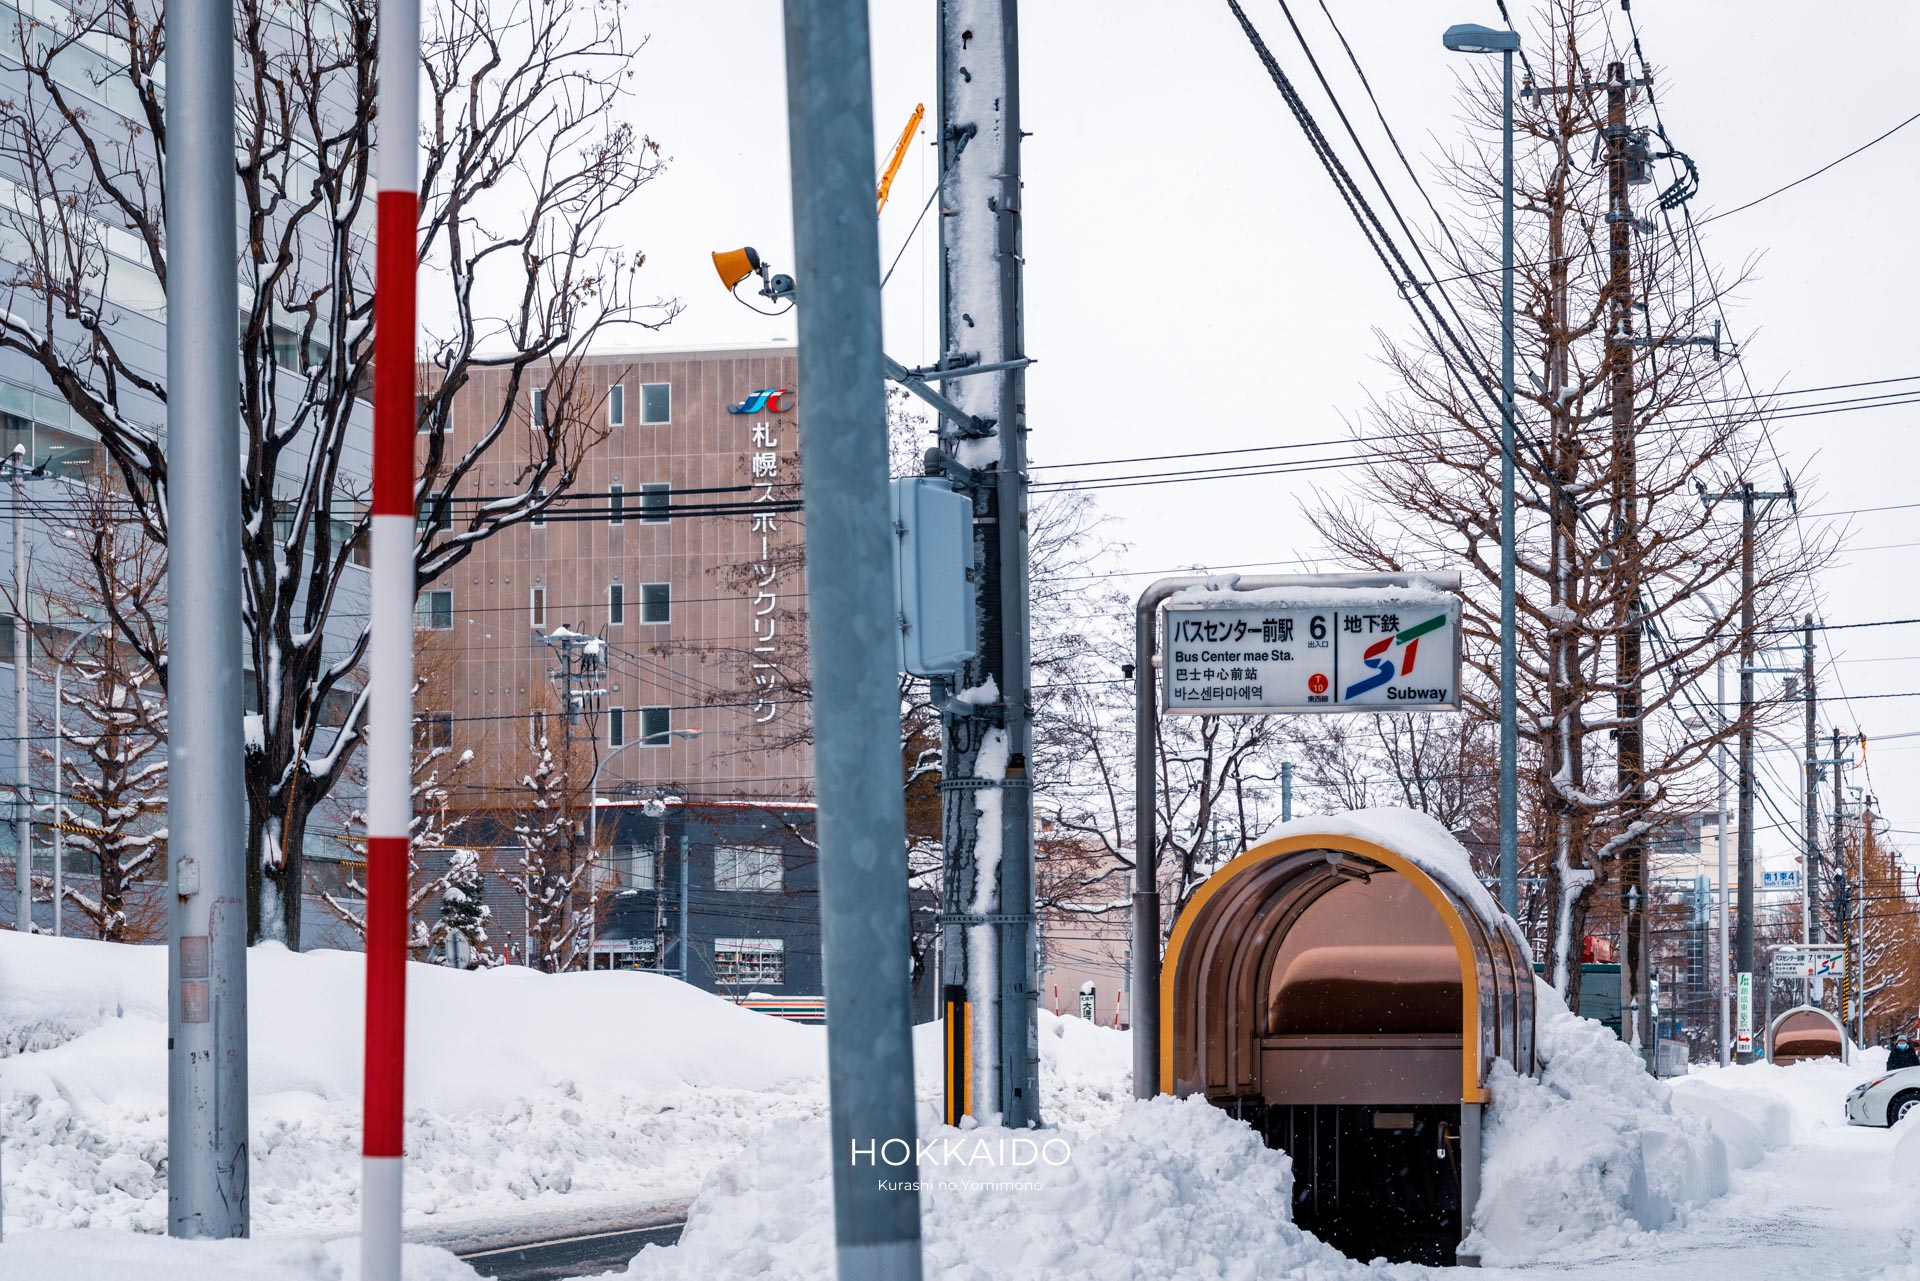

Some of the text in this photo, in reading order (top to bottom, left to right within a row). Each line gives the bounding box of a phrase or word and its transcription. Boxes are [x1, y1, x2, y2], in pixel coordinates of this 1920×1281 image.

[751, 422, 777, 723] 札幌スポーツクリニック
[1174, 618, 1294, 642] バスセンター前駅
[1309, 615, 1326, 640] 6
[1344, 614, 1400, 634] 地下鉄
[1307, 641, 1329, 649] 出入口
[1175, 649, 1295, 662] Bus Center mae Sta.
[1176, 667, 1258, 681] 巴士中心前站
[1315, 675, 1321, 683] T
[1174, 685, 1263, 701] 바스센타마에역
[1313, 684, 1324, 692] 10
[1387, 686, 1447, 702] Subway
[1764, 872, 1795, 881] 南1東4
